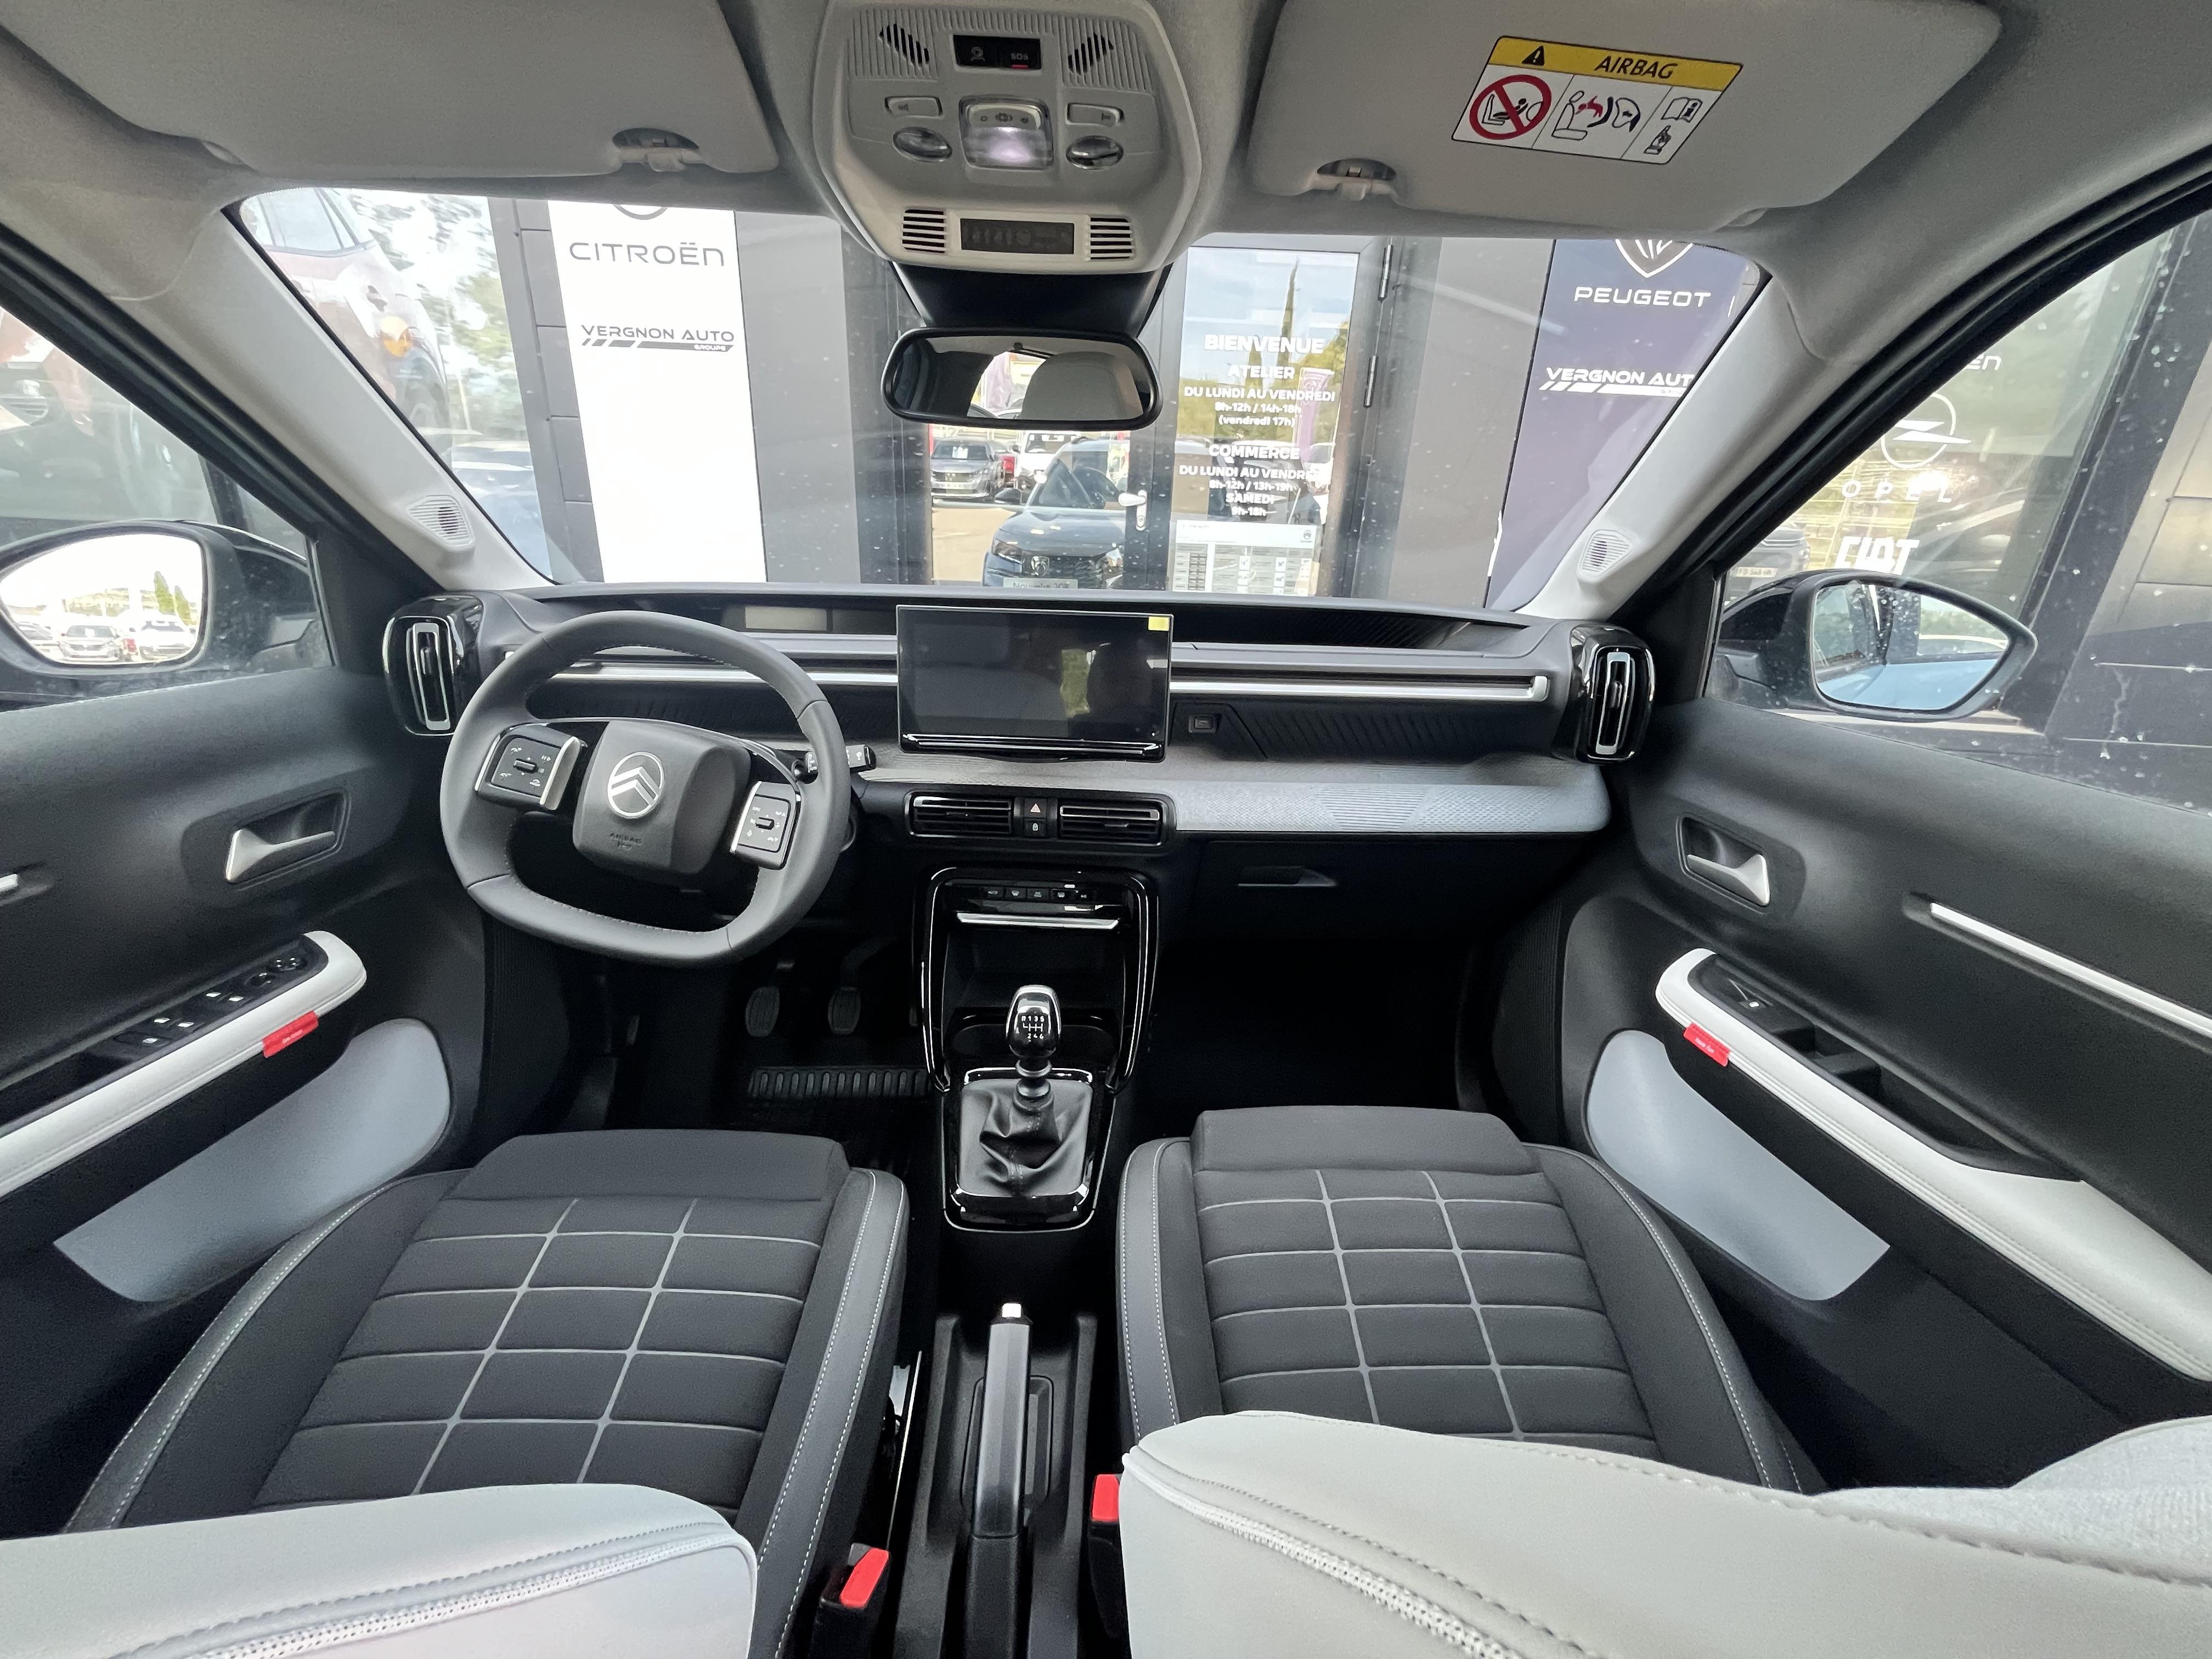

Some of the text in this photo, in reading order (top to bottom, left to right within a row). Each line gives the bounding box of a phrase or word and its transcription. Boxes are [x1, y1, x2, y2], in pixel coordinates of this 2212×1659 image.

[1594, 55, 1679, 80] AIRBAG
[1573, 286, 1712, 307] PEUGEOT
[581, 324, 735, 342] VERGNON AUTO
[1204, 334, 1324, 353] BIENVENUE
[1227, 364, 1295, 380] ATELIER
[1545, 367, 1695, 387] VERGNON AUT
[1184, 386, 1335, 402] DU LUNDI AU VENDREDI
[1260, 403, 1302, 414] 14h-18h
[1218, 414, 1271, 425] (vendredi
[1208, 444, 1300, 460] COMMERCE
[1179, 465, 1198, 475] DU
[1200, 466, 1238, 478] LUNDI
[1239, 467, 1260, 478] AU
[1226, 492, 1274, 504] SAMEDI
[1841, 479, 1953, 504] OPEL
[1833, 535, 1920, 575] FIAT
